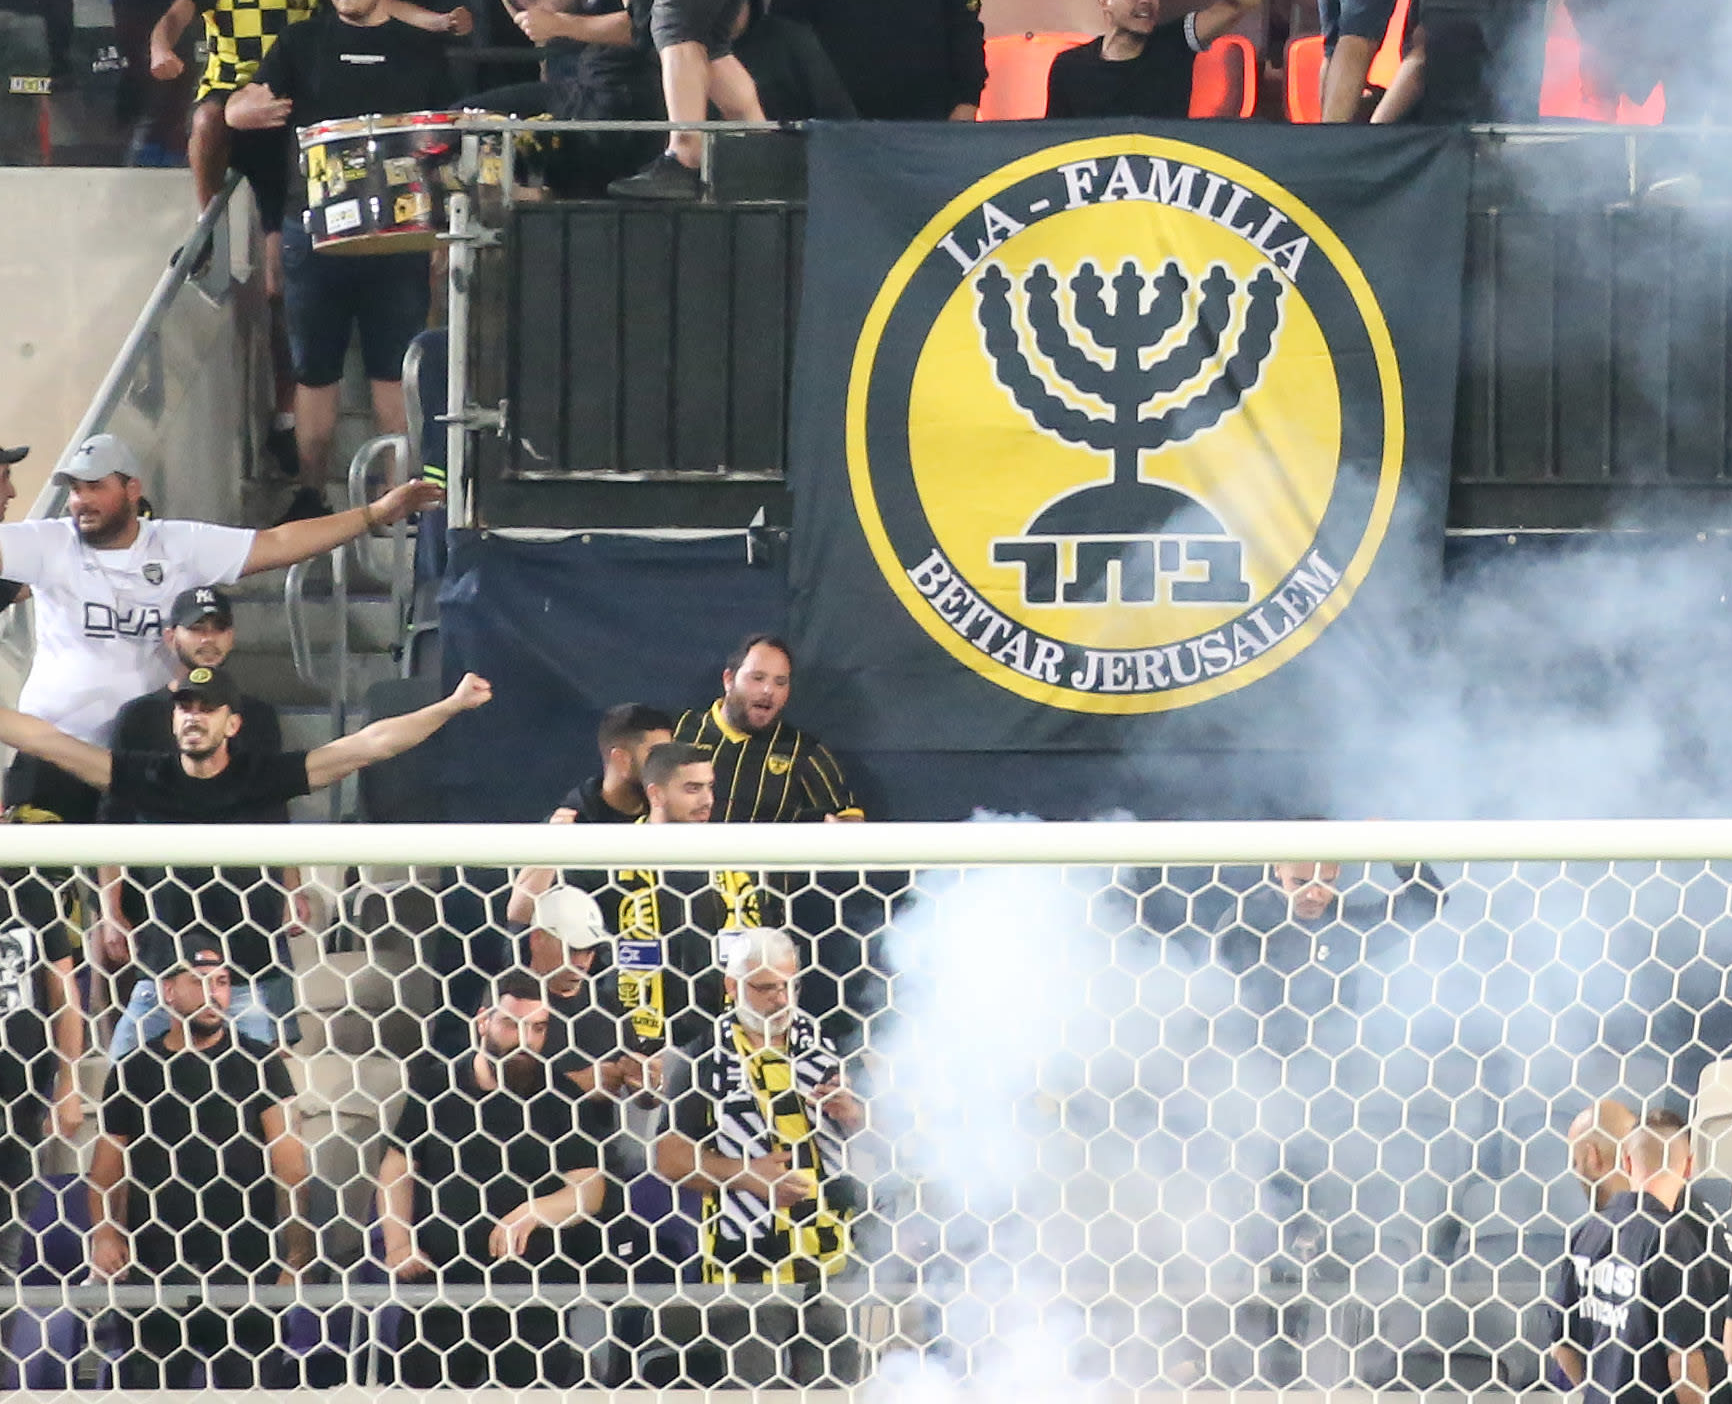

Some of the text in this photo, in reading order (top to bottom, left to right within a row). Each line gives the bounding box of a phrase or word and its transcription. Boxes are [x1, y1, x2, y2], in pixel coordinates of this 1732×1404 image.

[906, 548, 1342, 693] BEITAR JERUSALEM
[988, 537, 1252, 607] ביתר
